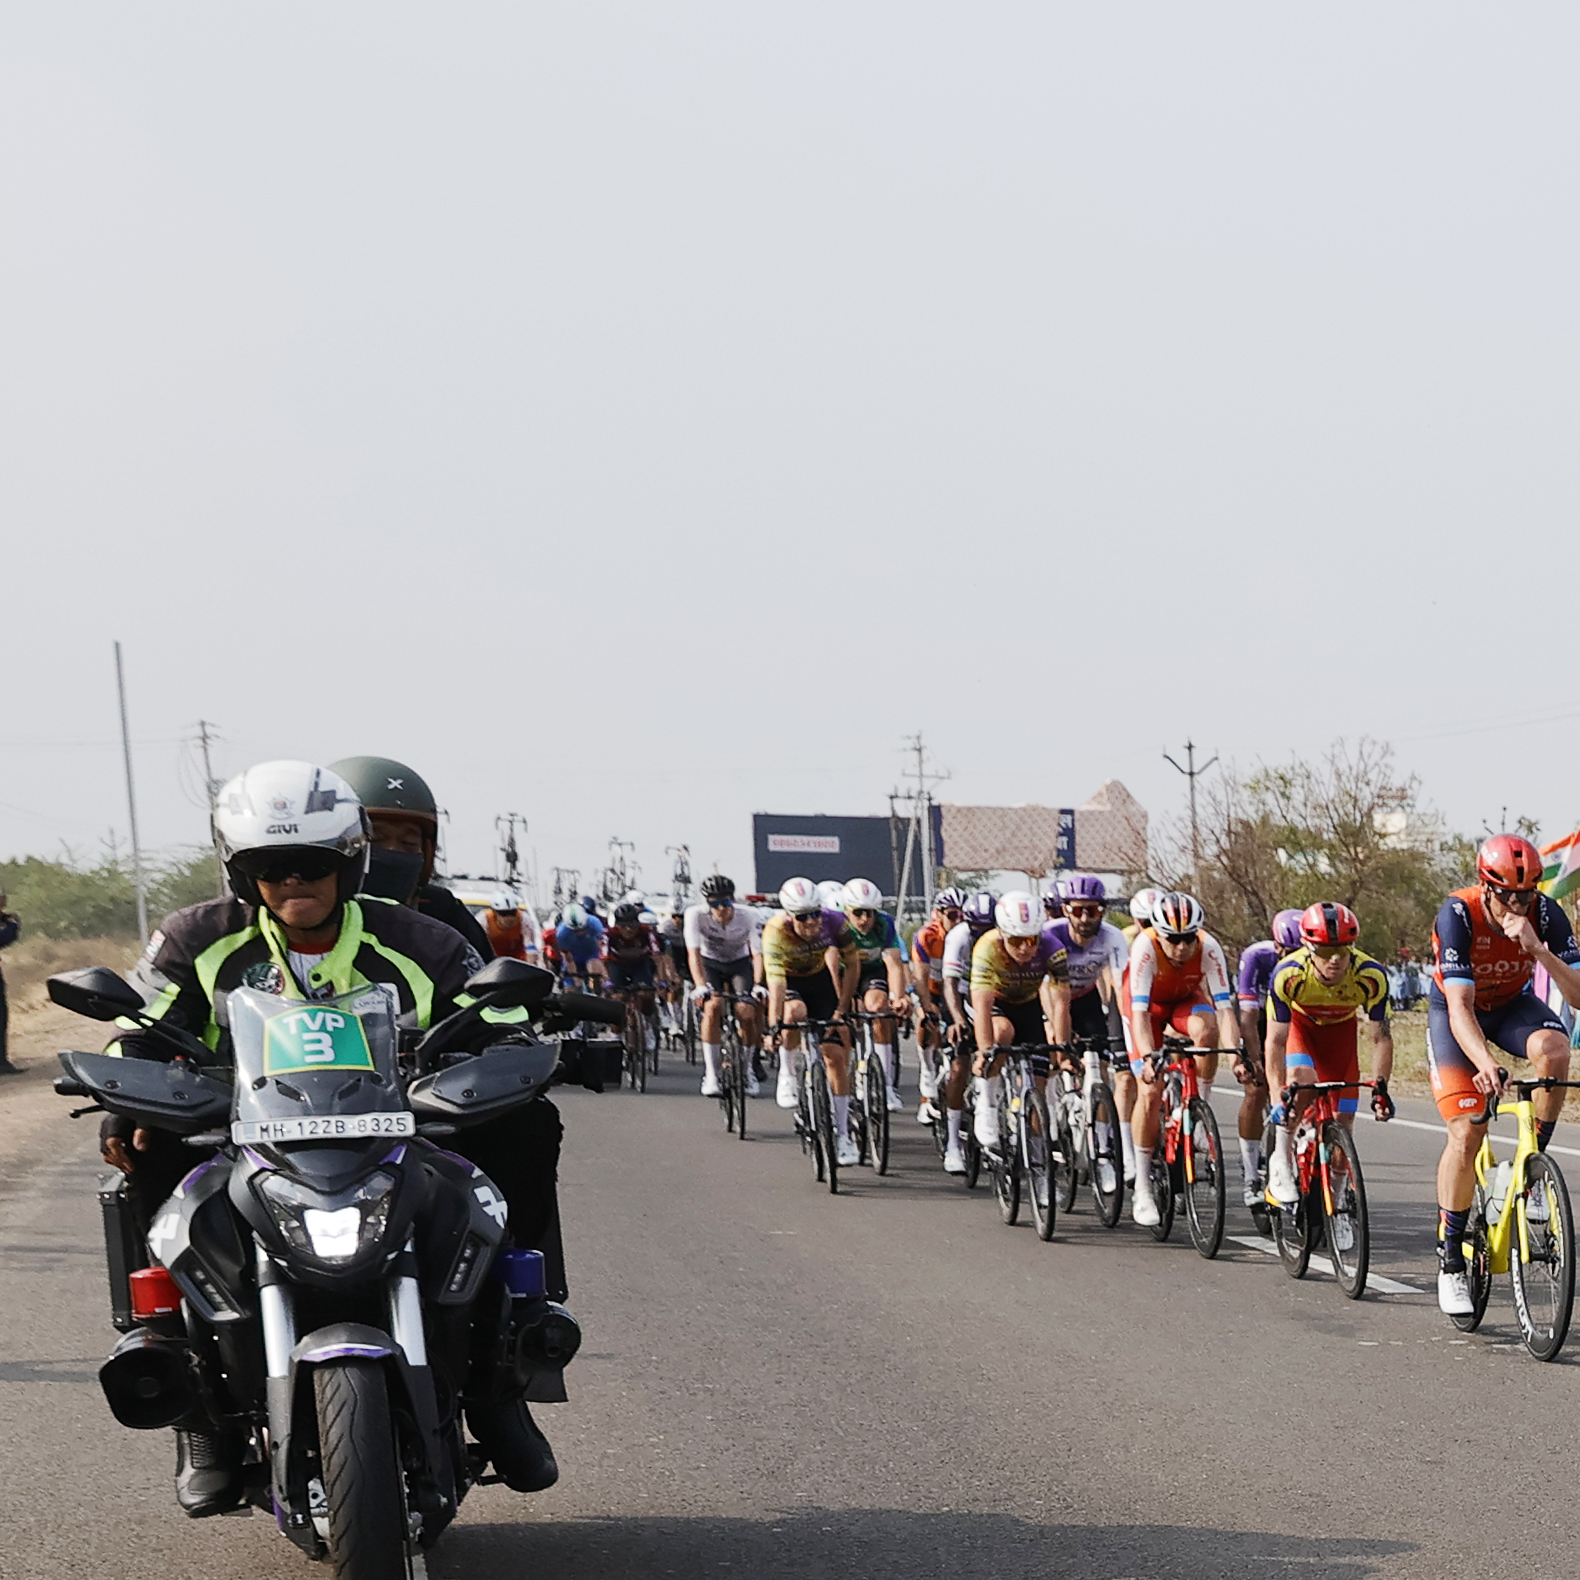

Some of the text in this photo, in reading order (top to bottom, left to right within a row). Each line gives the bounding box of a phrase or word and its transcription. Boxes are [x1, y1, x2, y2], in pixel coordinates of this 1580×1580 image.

[265, 822, 300, 836] GIVI
[281, 1010, 346, 1034] TVP
[302, 1033, 336, 1064] 3
